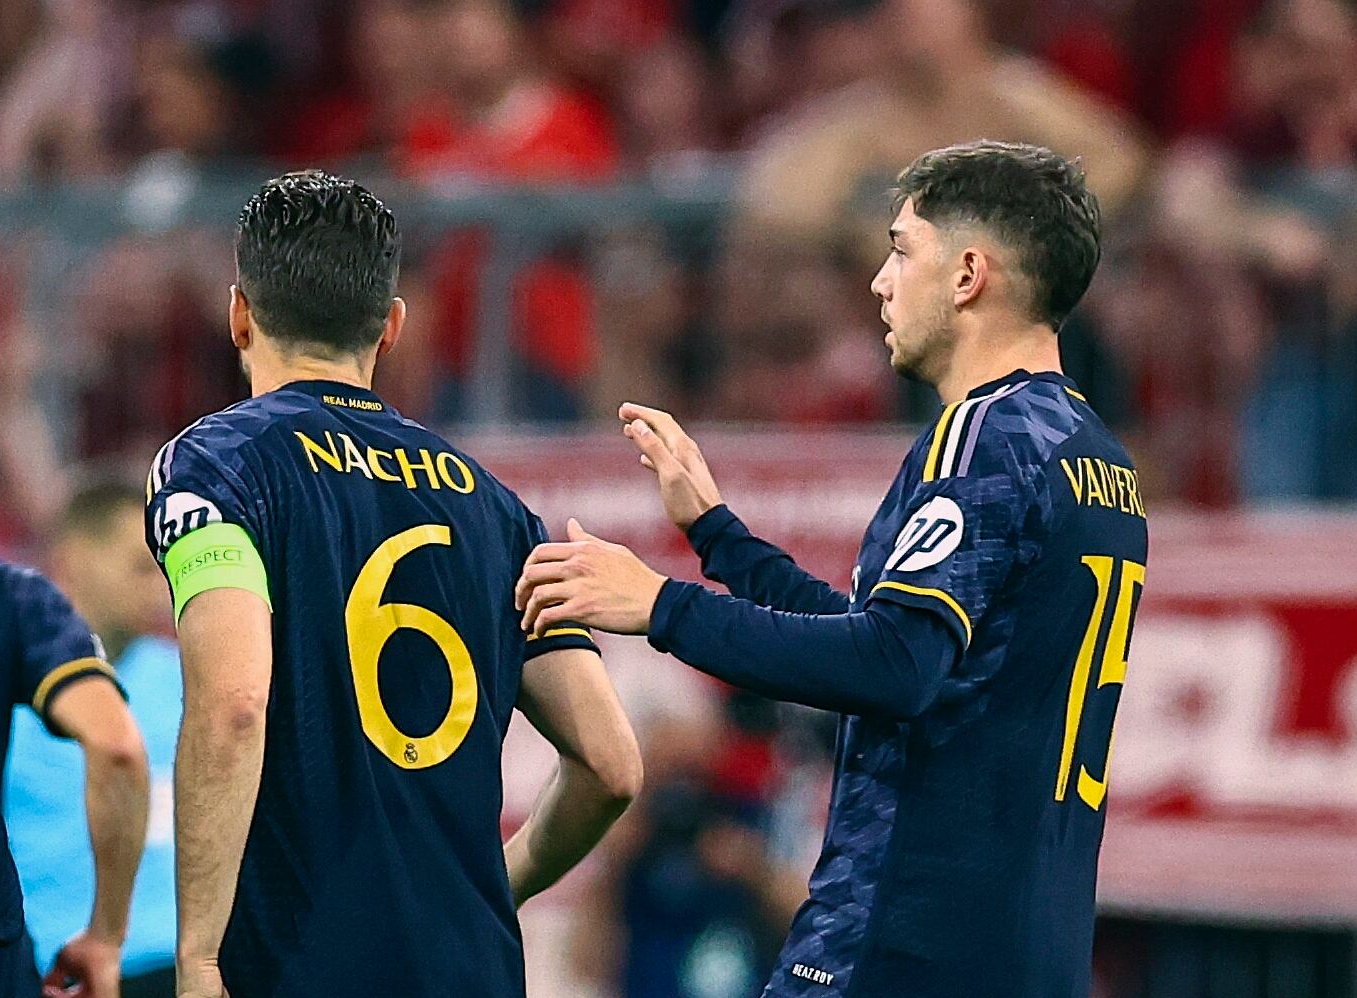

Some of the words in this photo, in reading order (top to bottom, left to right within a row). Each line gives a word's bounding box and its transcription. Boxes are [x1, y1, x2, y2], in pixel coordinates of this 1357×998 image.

[323, 395, 348, 407] REAL
[349, 398, 383, 412] MADRID
[294, 430, 476, 495] NACHO
[1059, 457, 1147, 519] VALVER
[181, 549, 245, 578] RESPECT
[344, 523, 479, 771] 6
